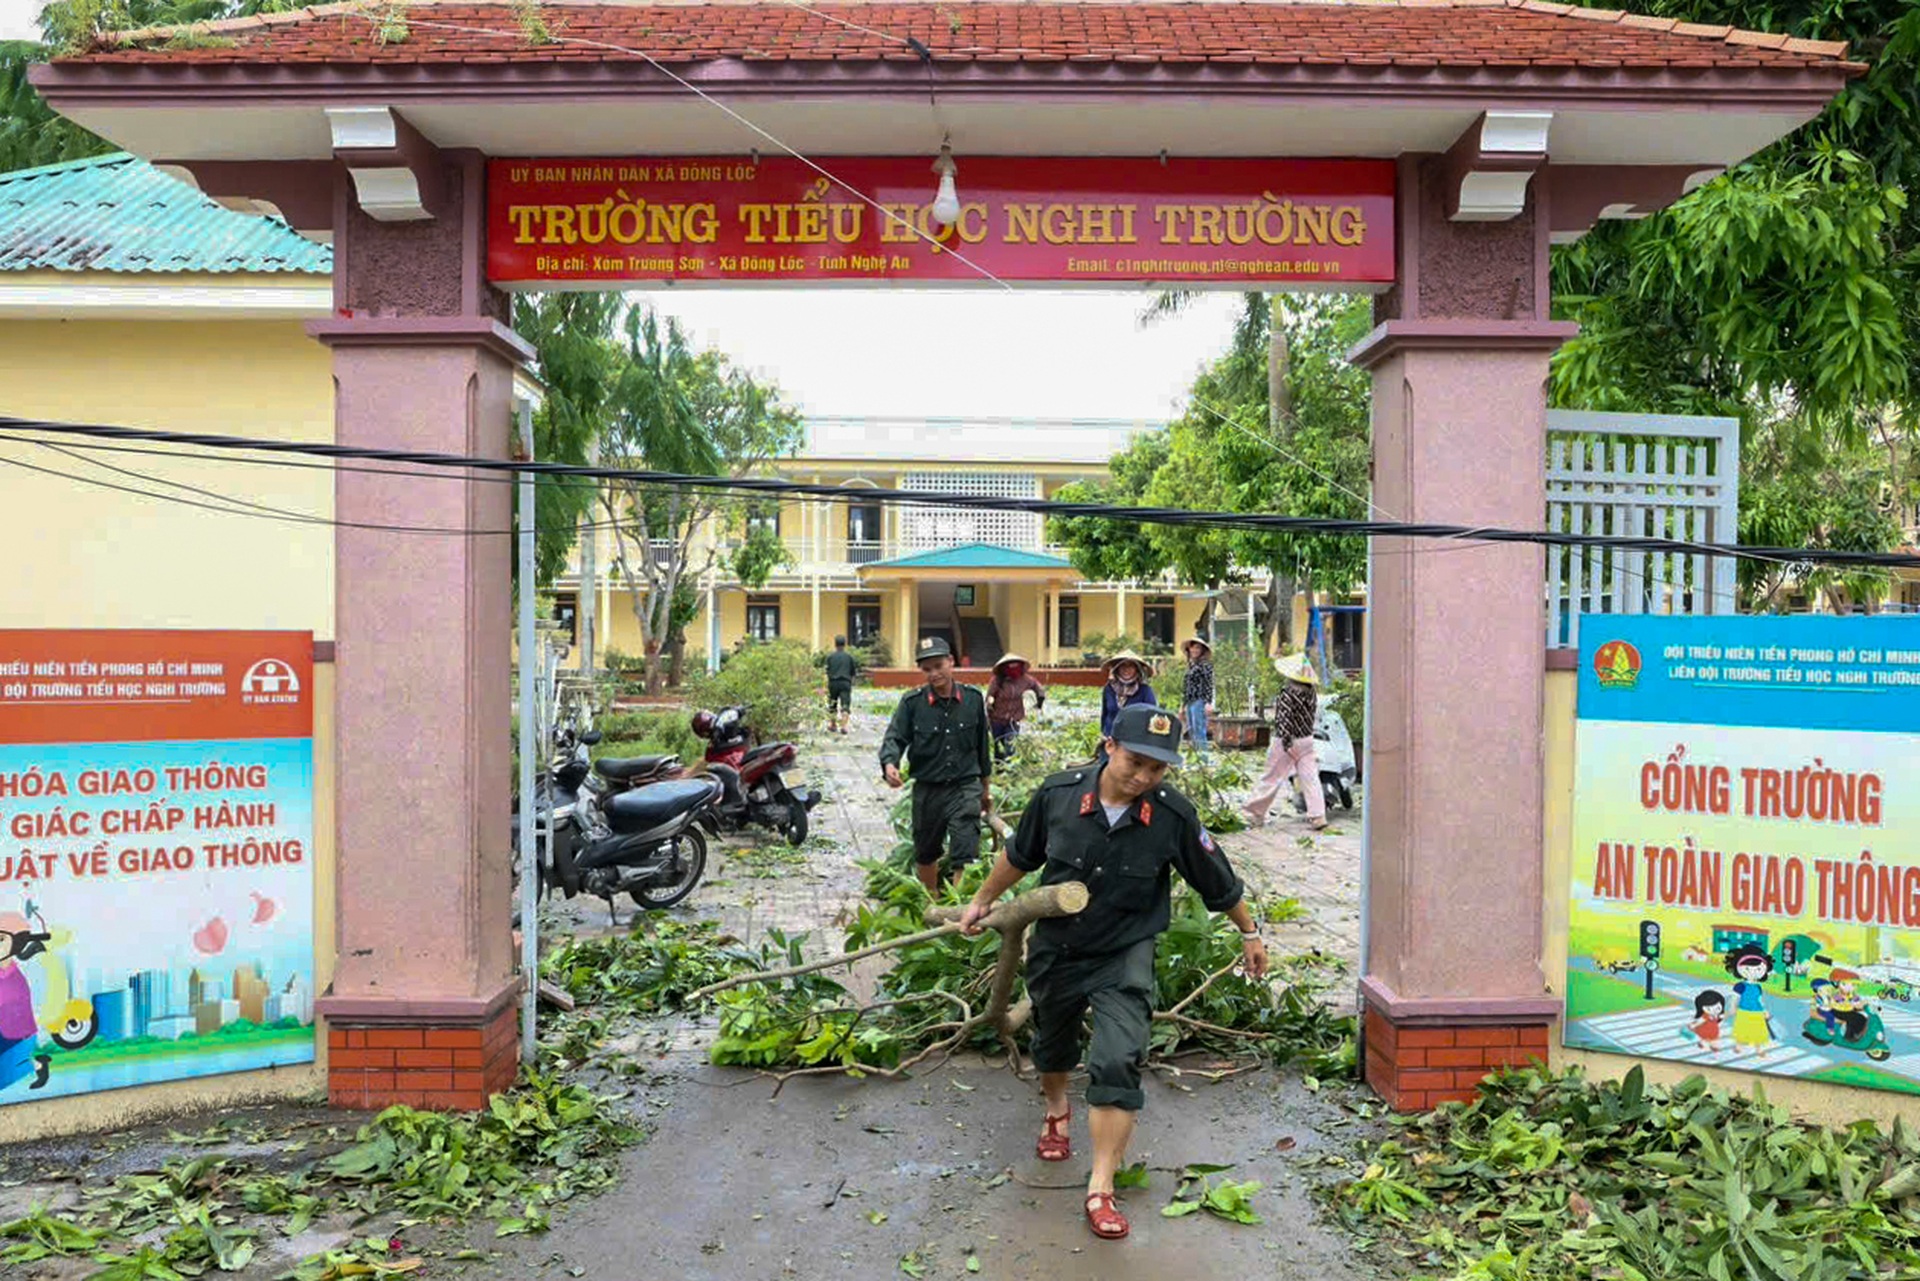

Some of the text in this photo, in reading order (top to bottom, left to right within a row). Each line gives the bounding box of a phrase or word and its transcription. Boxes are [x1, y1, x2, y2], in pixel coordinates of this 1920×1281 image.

[535, 167, 566, 182] BAN
[571, 164, 614, 182] NHÂN
[618, 164, 650, 182] DÂN
[655, 164, 675, 182] XÃ
[509, 178, 1367, 253] TRƯỜNG TIỂU HỌC NGHI TRƯỜNG
[536, 256, 559, 275] Địa
[593, 255, 624, 271] Xóm
[679, 256, 704, 271] Sơn
[890, 256, 909, 270] An
[101, 663, 143, 675] PHONG
[191, 663, 223, 675] MINH
[1790, 649, 1834, 662] PHONG
[1886, 651, 1920, 664] MINH
[146, 683, 175, 695] NGHI
[1836, 671, 1867, 684] NGHI
[0, 762, 266, 797] HÓA GIAO THÔNG
[1640, 744, 1881, 825] CỔNG TRƯỜNG
[11, 798, 275, 839] GIÁC CHẤP HÀNH
[68, 841, 108, 876] VỀ
[118, 847, 193, 873] GIAO
[203, 838, 303, 867] THÔNG
[1593, 837, 1920, 928] AN TOÀN GIAO THÔNG
